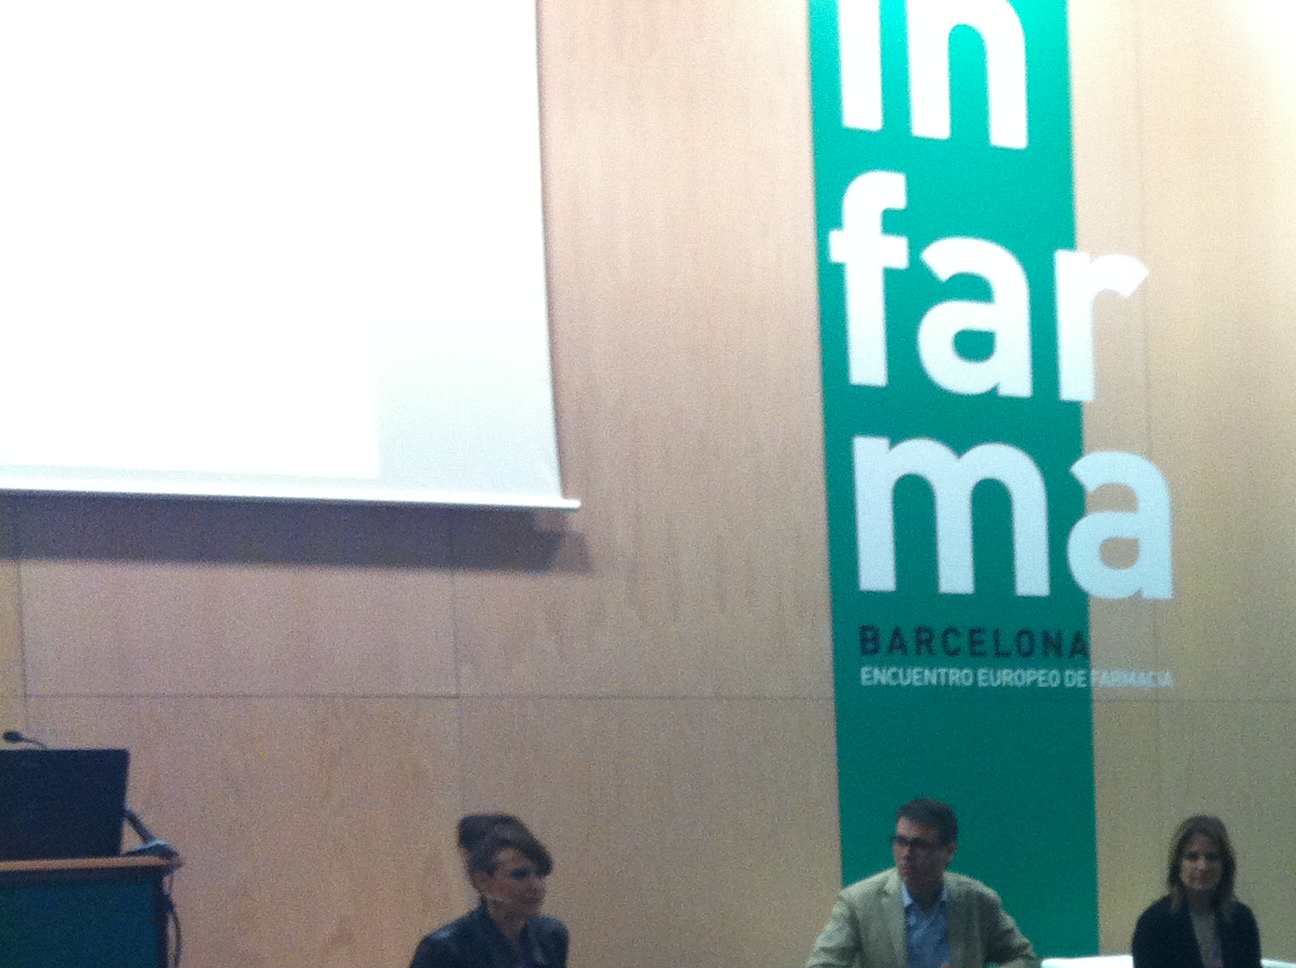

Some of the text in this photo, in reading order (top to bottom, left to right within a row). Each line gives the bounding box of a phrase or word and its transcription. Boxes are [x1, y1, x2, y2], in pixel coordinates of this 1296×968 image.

[836, 0, 1029, 149] in
[828, 169, 1149, 403] far
[852, 434, 1174, 600] ma
[858, 624, 1092, 660] BARCELONA
[860, 666, 974, 688] ENCUENTRO
[977, 667, 1061, 689] EUROPEO
[1063, 669, 1088, 689] DE
